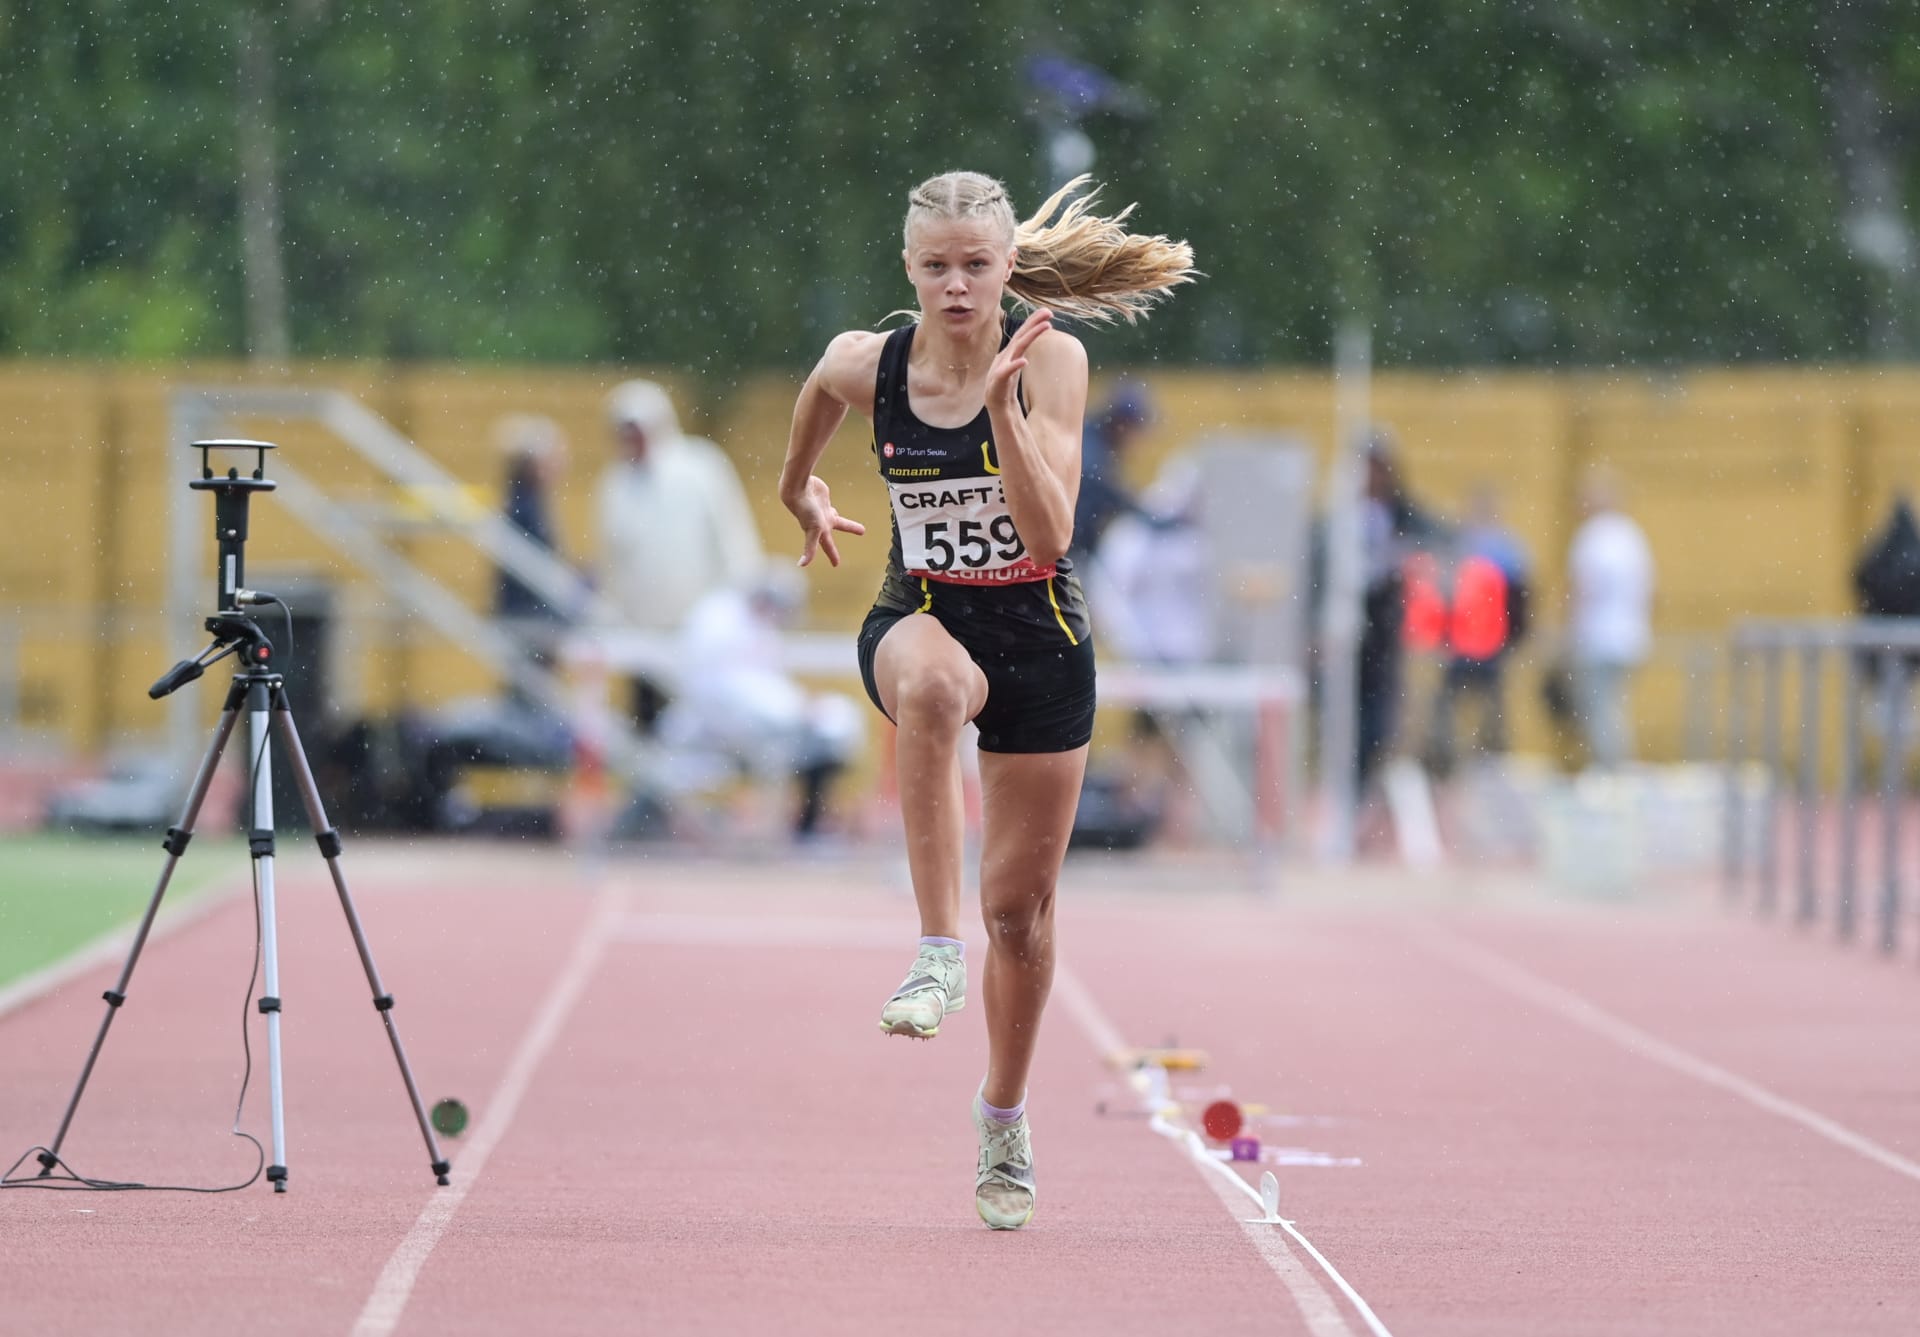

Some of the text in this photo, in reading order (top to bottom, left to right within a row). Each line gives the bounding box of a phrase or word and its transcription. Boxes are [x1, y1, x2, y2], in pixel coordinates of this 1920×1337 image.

[895, 447, 906, 456] OP
[907, 447, 926, 456] Turun
[888, 467, 941, 477] noname
[899, 486, 993, 509] CRAFT
[925, 515, 1026, 571] 559
